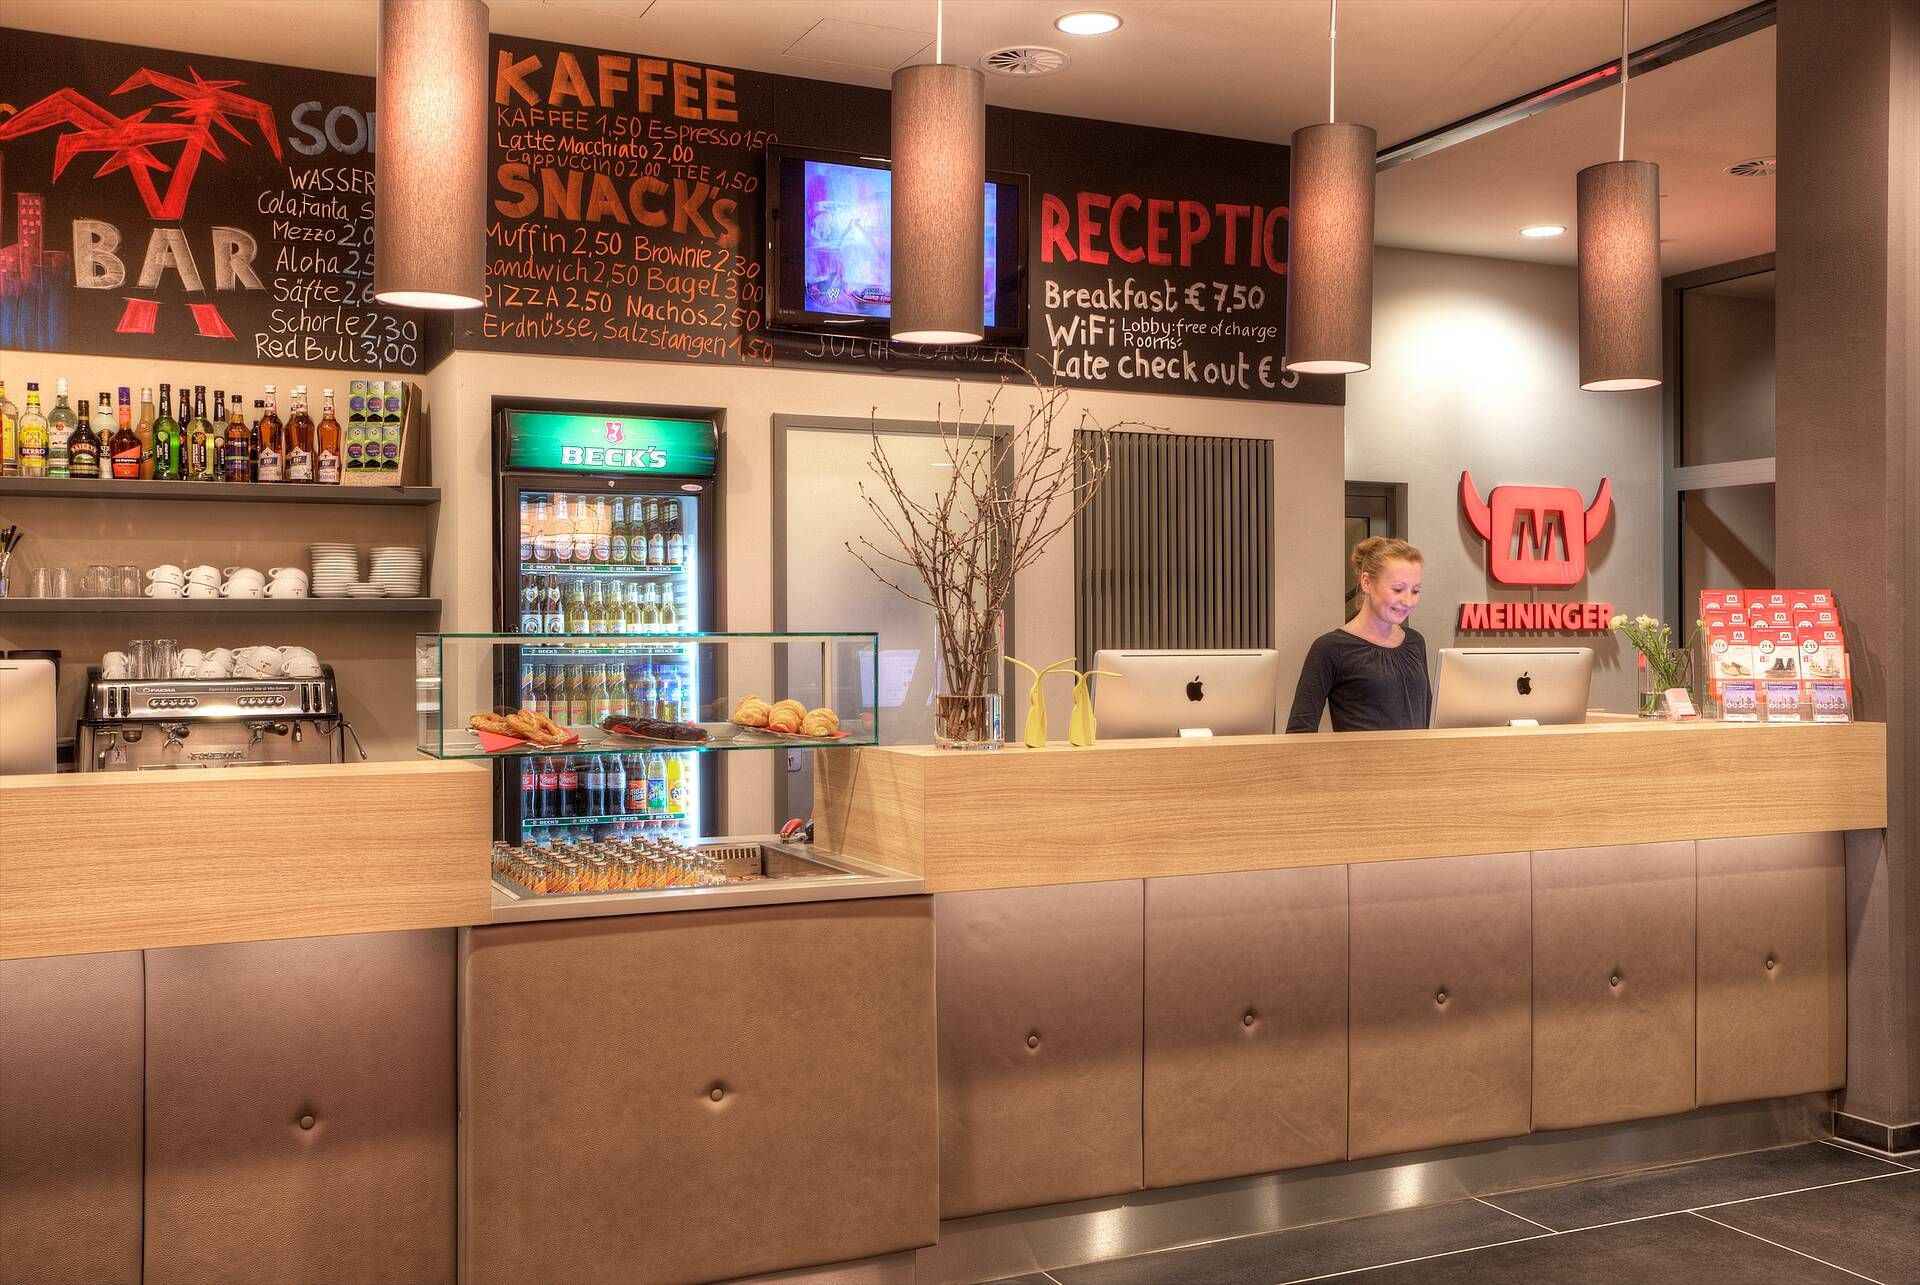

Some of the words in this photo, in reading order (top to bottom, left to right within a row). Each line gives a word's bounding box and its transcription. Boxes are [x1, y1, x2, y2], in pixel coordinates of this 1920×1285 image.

[495, 49, 739, 123] KAFFEE
[497, 106, 589, 131] KAFFEE
[596, 113, 642, 138] 1,50
[648, 119, 741, 147] Espresso
[497, 131, 556, 151] Latte
[558, 135, 648, 159] Macchiato
[289, 166, 376, 196] WASSER
[505, 150, 624, 177] Cappuccino
[671, 164, 711, 183] TEE
[716, 170, 758, 193] 1,50
[273, 219, 336, 243] Mezzo
[485, 221, 566, 255] Muffin
[571, 227, 622, 257] 2,50
[635, 236, 712, 270] Brownie
[713, 250, 761, 279] 2,30
[1040, 192, 1289, 275] RECEPTIO
[71, 217, 270, 297] BAR
[276, 246, 340, 273] Aloha
[273, 278, 342, 308] Säfte
[594, 260, 639, 289] 2,50
[647, 267, 719, 303] Bagel
[723, 279, 764, 304] 3,00
[1045, 277, 1180, 312] Breakfast
[269, 305, 360, 335] Schorle
[361, 313, 418, 347] 2,30
[484, 284, 560, 308] PIZZA
[626, 295, 707, 326] Nachos
[712, 303, 761, 332] 2,50
[603, 319, 726, 358] Salzstangen
[728, 336, 774, 363] 1,50
[1045, 313, 1116, 347] WiFi
[1210, 319, 1225, 337] of
[1225, 321, 1278, 343] charge
[255, 333, 299, 359] Red
[304, 337, 361, 362] Bull
[361, 341, 417, 370] 3,00
[1053, 348, 1110, 380] Late
[1118, 348, 1199, 383] check
[1203, 351, 1250, 390] out
[561, 446, 668, 469] BECK'S
[1508, 508, 1570, 562] M
[1461, 603, 1615, 630] MEININGER
